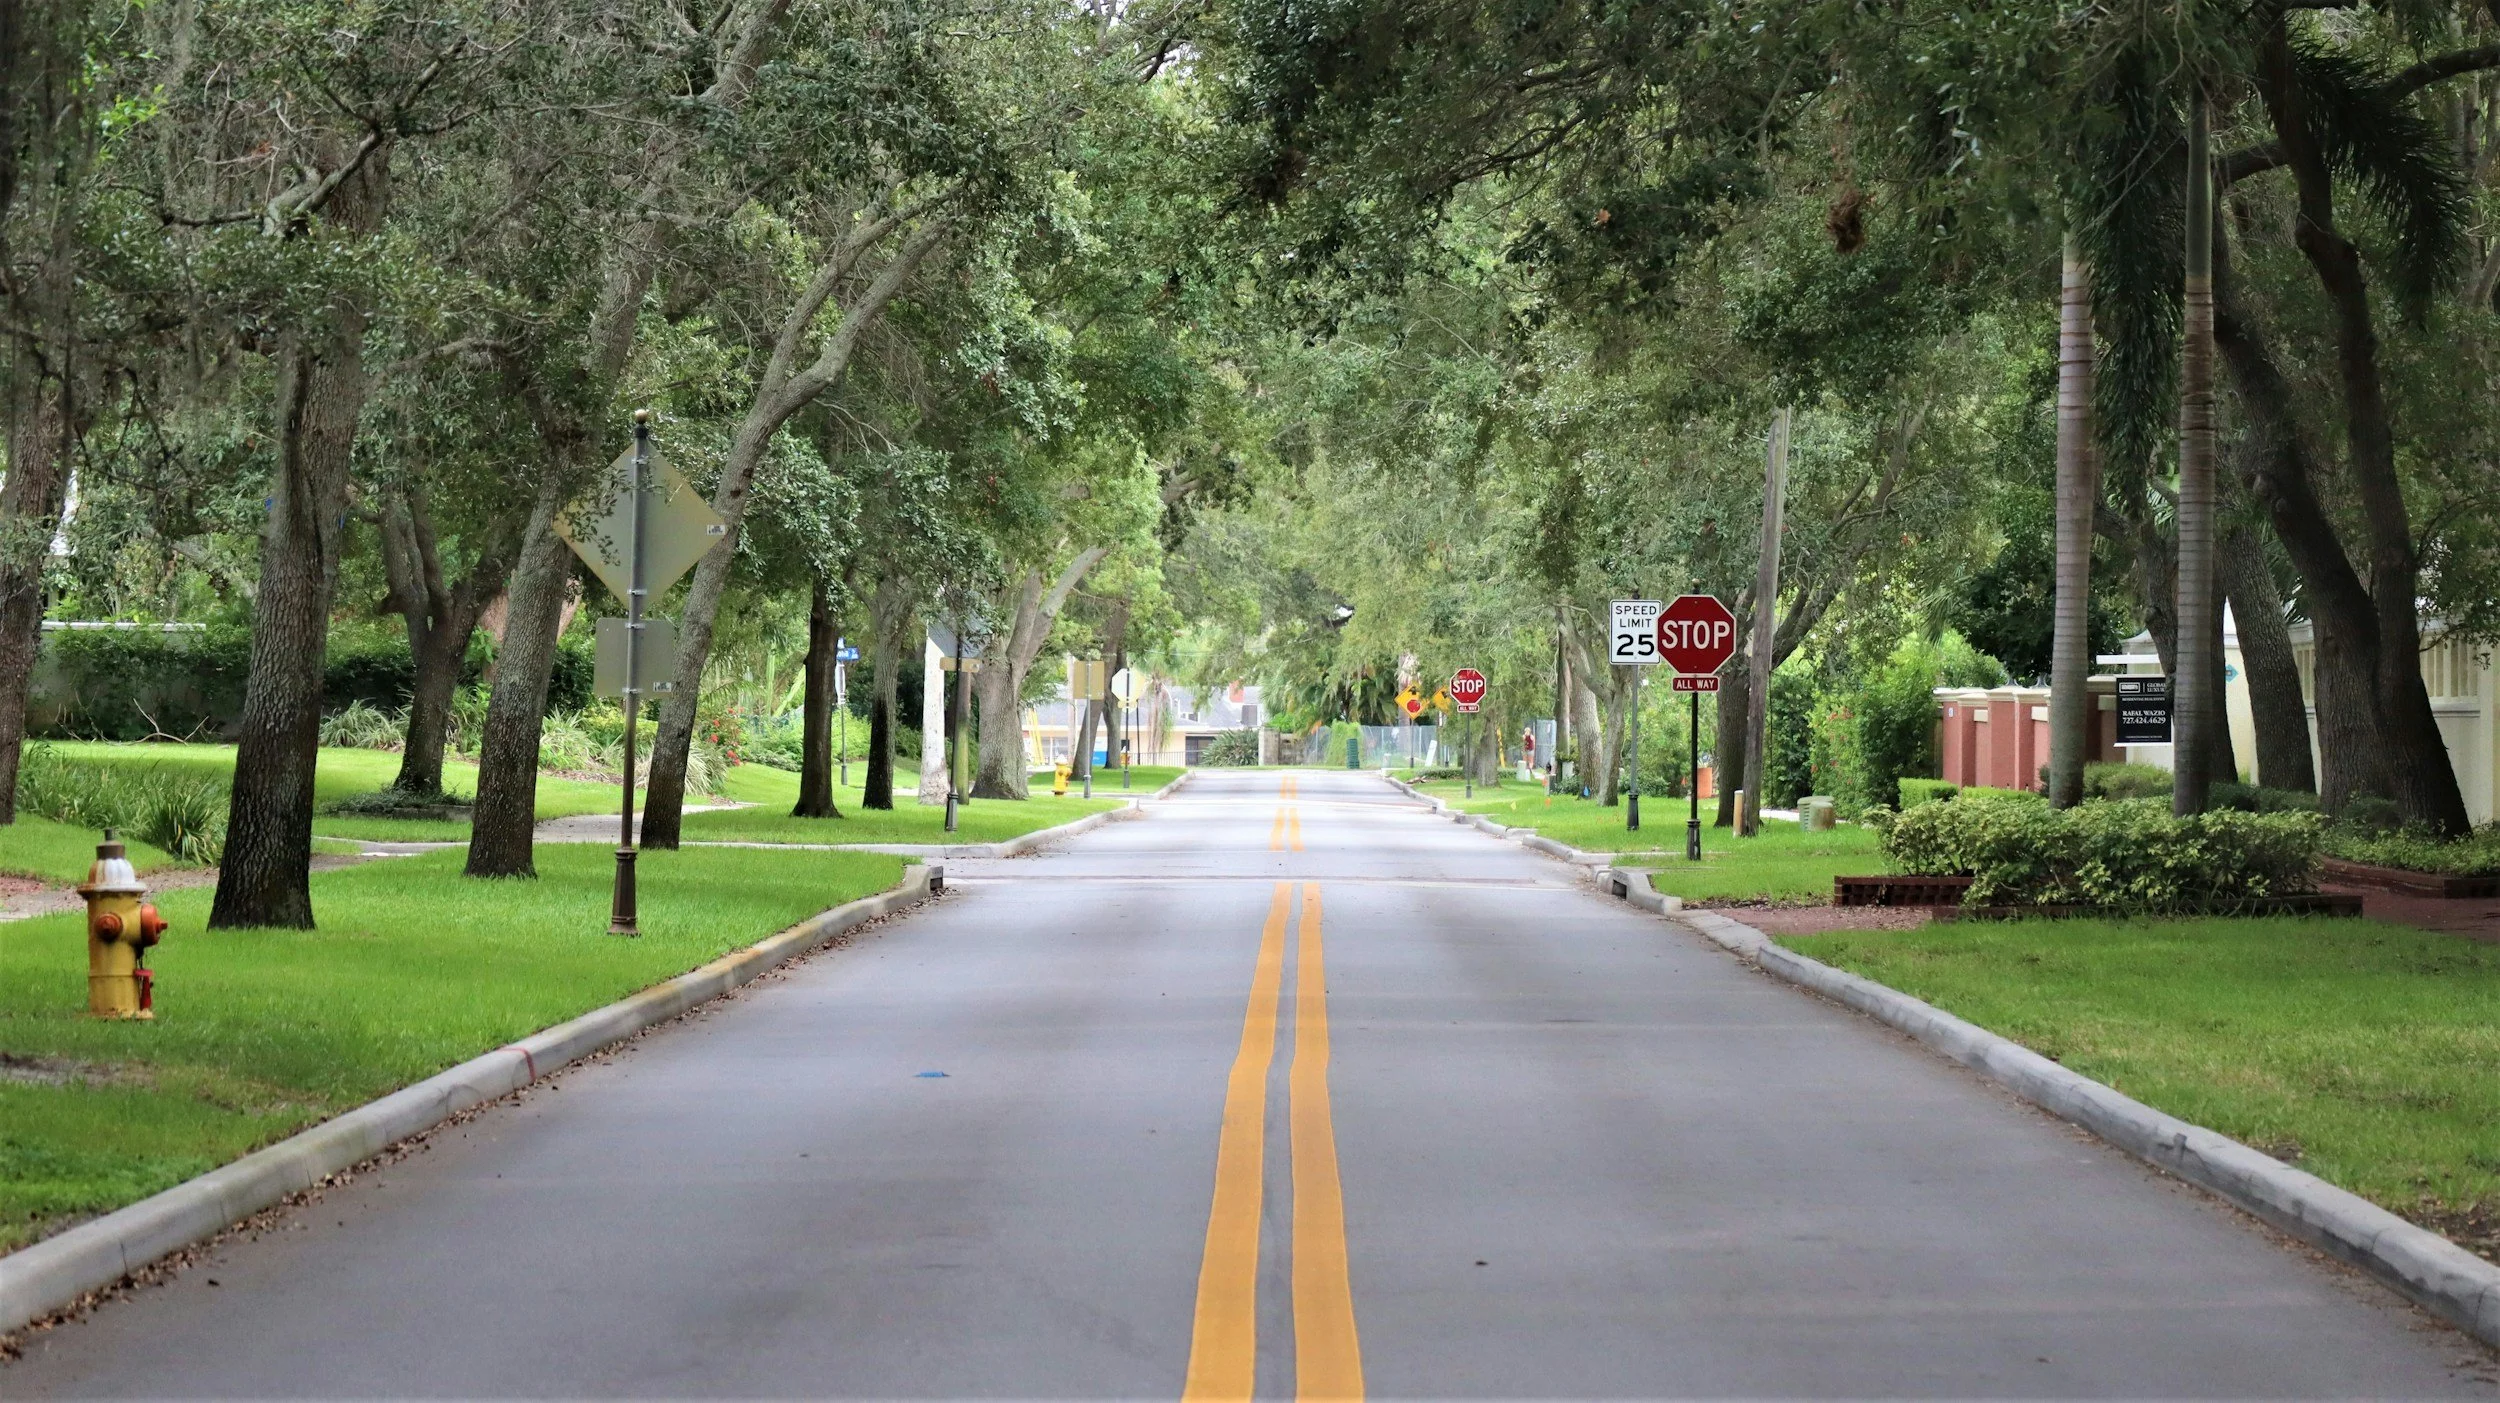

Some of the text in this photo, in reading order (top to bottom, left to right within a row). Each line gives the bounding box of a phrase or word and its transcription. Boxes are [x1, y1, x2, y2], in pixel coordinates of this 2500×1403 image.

[1615, 605, 1657, 615] SPEED
[1619, 618, 1652, 628] LIMIT
[1661, 620, 1731, 649] STOP
[1616, 633, 1655, 656] 25
[1452, 680, 1483, 693] STOP
[1676, 680, 1715, 689] ALL WAY
